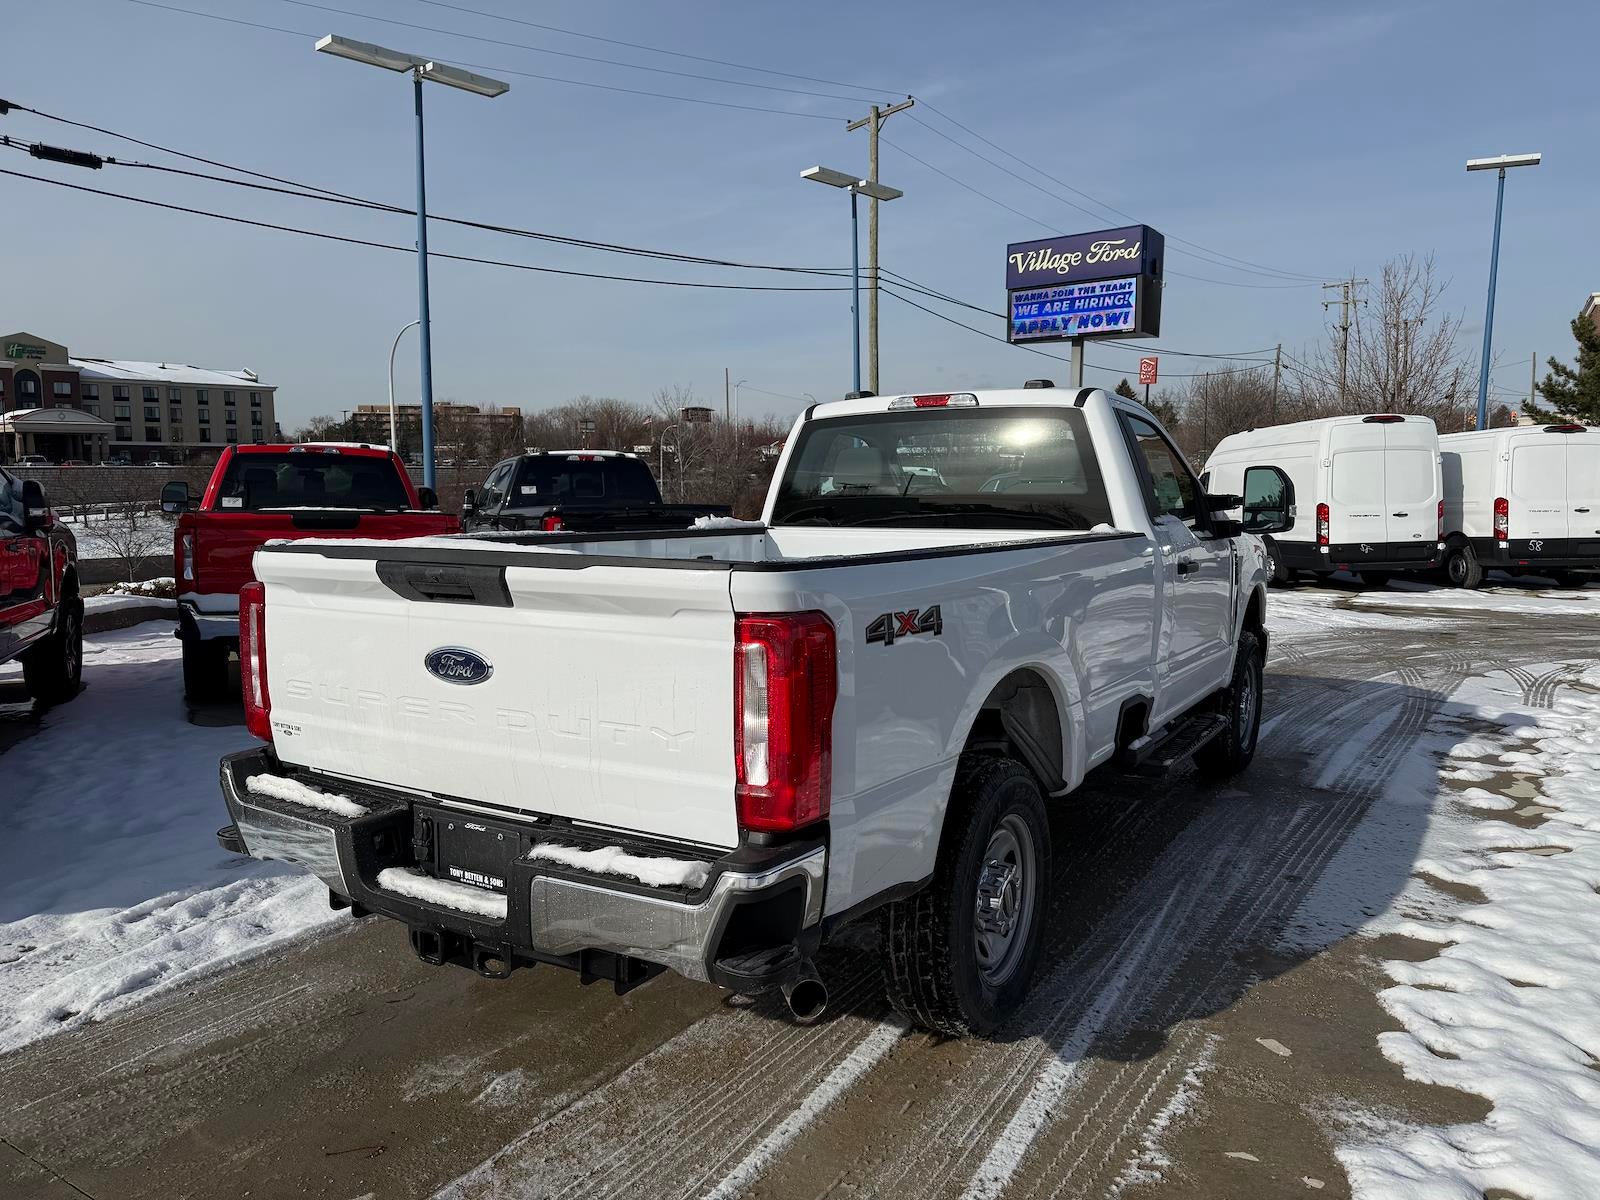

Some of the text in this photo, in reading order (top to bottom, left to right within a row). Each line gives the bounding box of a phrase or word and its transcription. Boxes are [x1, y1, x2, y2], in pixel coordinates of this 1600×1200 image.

[1009, 239, 1141, 274] Village Ford
[1015, 282, 1133, 303] WANNA JOIN THE TEAM?
[1018, 295, 1130, 316] WE ARE HIRING!
[1015, 311, 1131, 335] APPLY NOW!
[1528, 539, 1544, 552] 58
[438, 653, 474, 678] Ford
[286, 678, 696, 753] SUPER DUTY
[464, 823, 486, 831] Ford
[449, 868, 504, 888] TONY BETTEN & SONS
